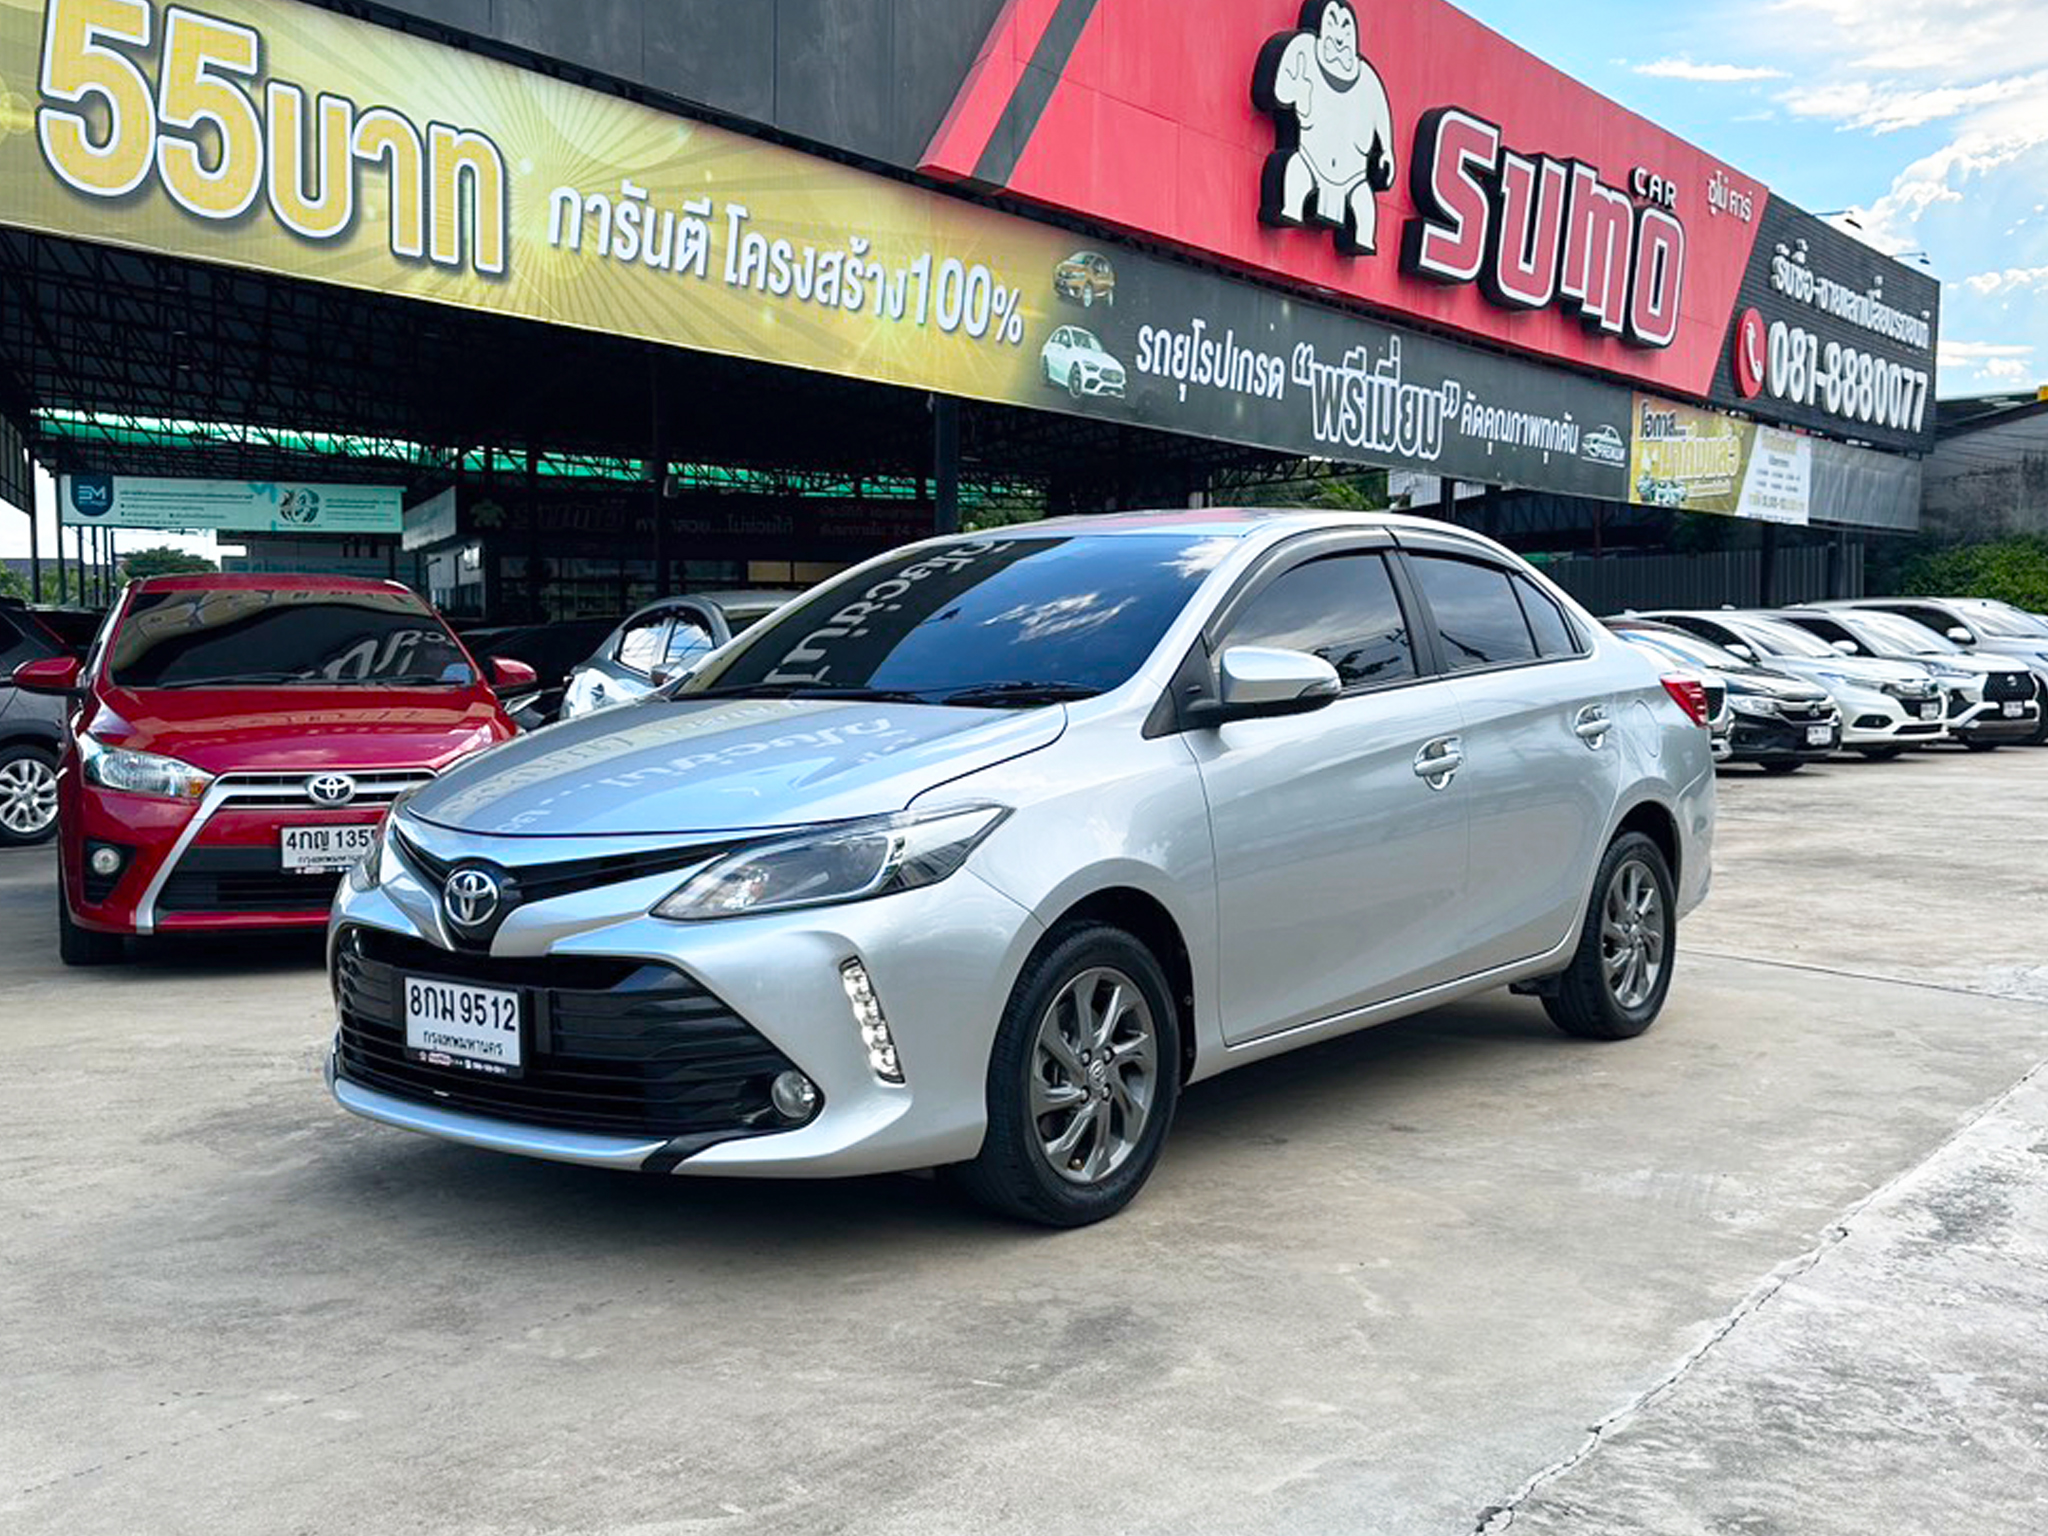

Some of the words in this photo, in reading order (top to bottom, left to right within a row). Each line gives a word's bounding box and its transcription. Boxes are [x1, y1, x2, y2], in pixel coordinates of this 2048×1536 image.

[548, 179, 712, 277] การันตี
[1631, 165, 1678, 210] CAR
[1136, 319, 1285, 402] รถยุโรปเกรด
[1767, 320, 1929, 434] 081-8880077
[459, 991, 517, 1032] 9512
